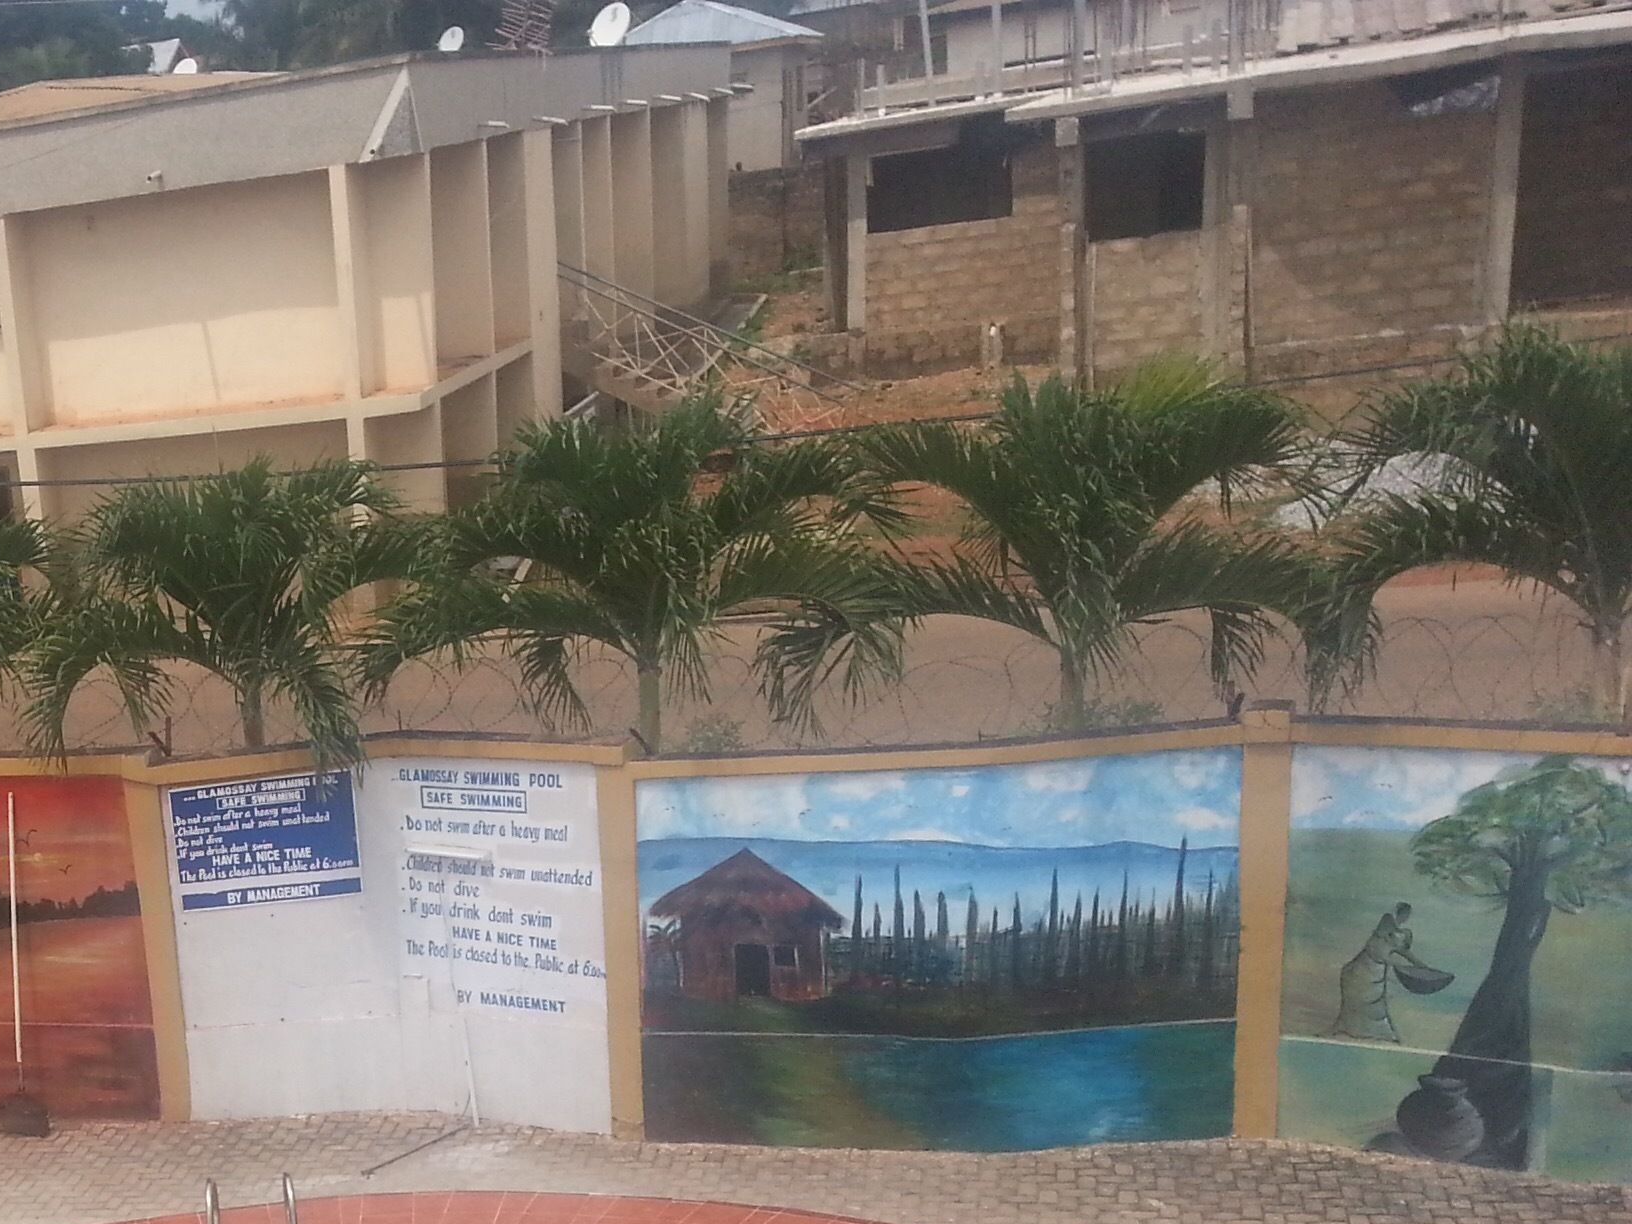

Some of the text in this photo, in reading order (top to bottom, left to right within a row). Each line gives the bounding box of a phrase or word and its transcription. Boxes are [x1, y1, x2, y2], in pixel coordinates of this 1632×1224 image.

[261, 777, 310, 791] SWIMMING
[399, 768, 563, 788] GLAMOSSAY SWIMMING POOL
[222, 791, 301, 807] SAFE SWIMMING
[427, 791, 522, 808] SAFE SWIMMING
[188, 813, 201, 824] not
[242, 819, 255, 830] not
[406, 814, 567, 843] Do not swim after a heavy meal
[191, 836, 203, 846] not
[212, 847, 312, 866] HAVE A NICE TIME
[181, 870, 196, 882] The
[229, 864, 257, 877] closed
[310, 858, 320, 869] at
[448, 859, 477, 876] should
[481, 863, 495, 877] not
[499, 867, 525, 880] swim
[531, 868, 593, 887] unattended
[227, 884, 320, 904] BY MANAGEMENT
[409, 876, 480, 898] Do not dive
[410, 897, 552, 929] If you drink dont swim
[452, 926, 556, 950] HAVE A NICE TIME
[406, 939, 424, 956] The
[453, 943, 462, 959] is
[465, 946, 498, 964] closed
[501, 951, 512, 965] to
[514, 952, 529, 968] the
[535, 952, 564, 973] Public
[568, 959, 579, 975] at
[457, 990, 566, 1014] BY MANAGEMENT
